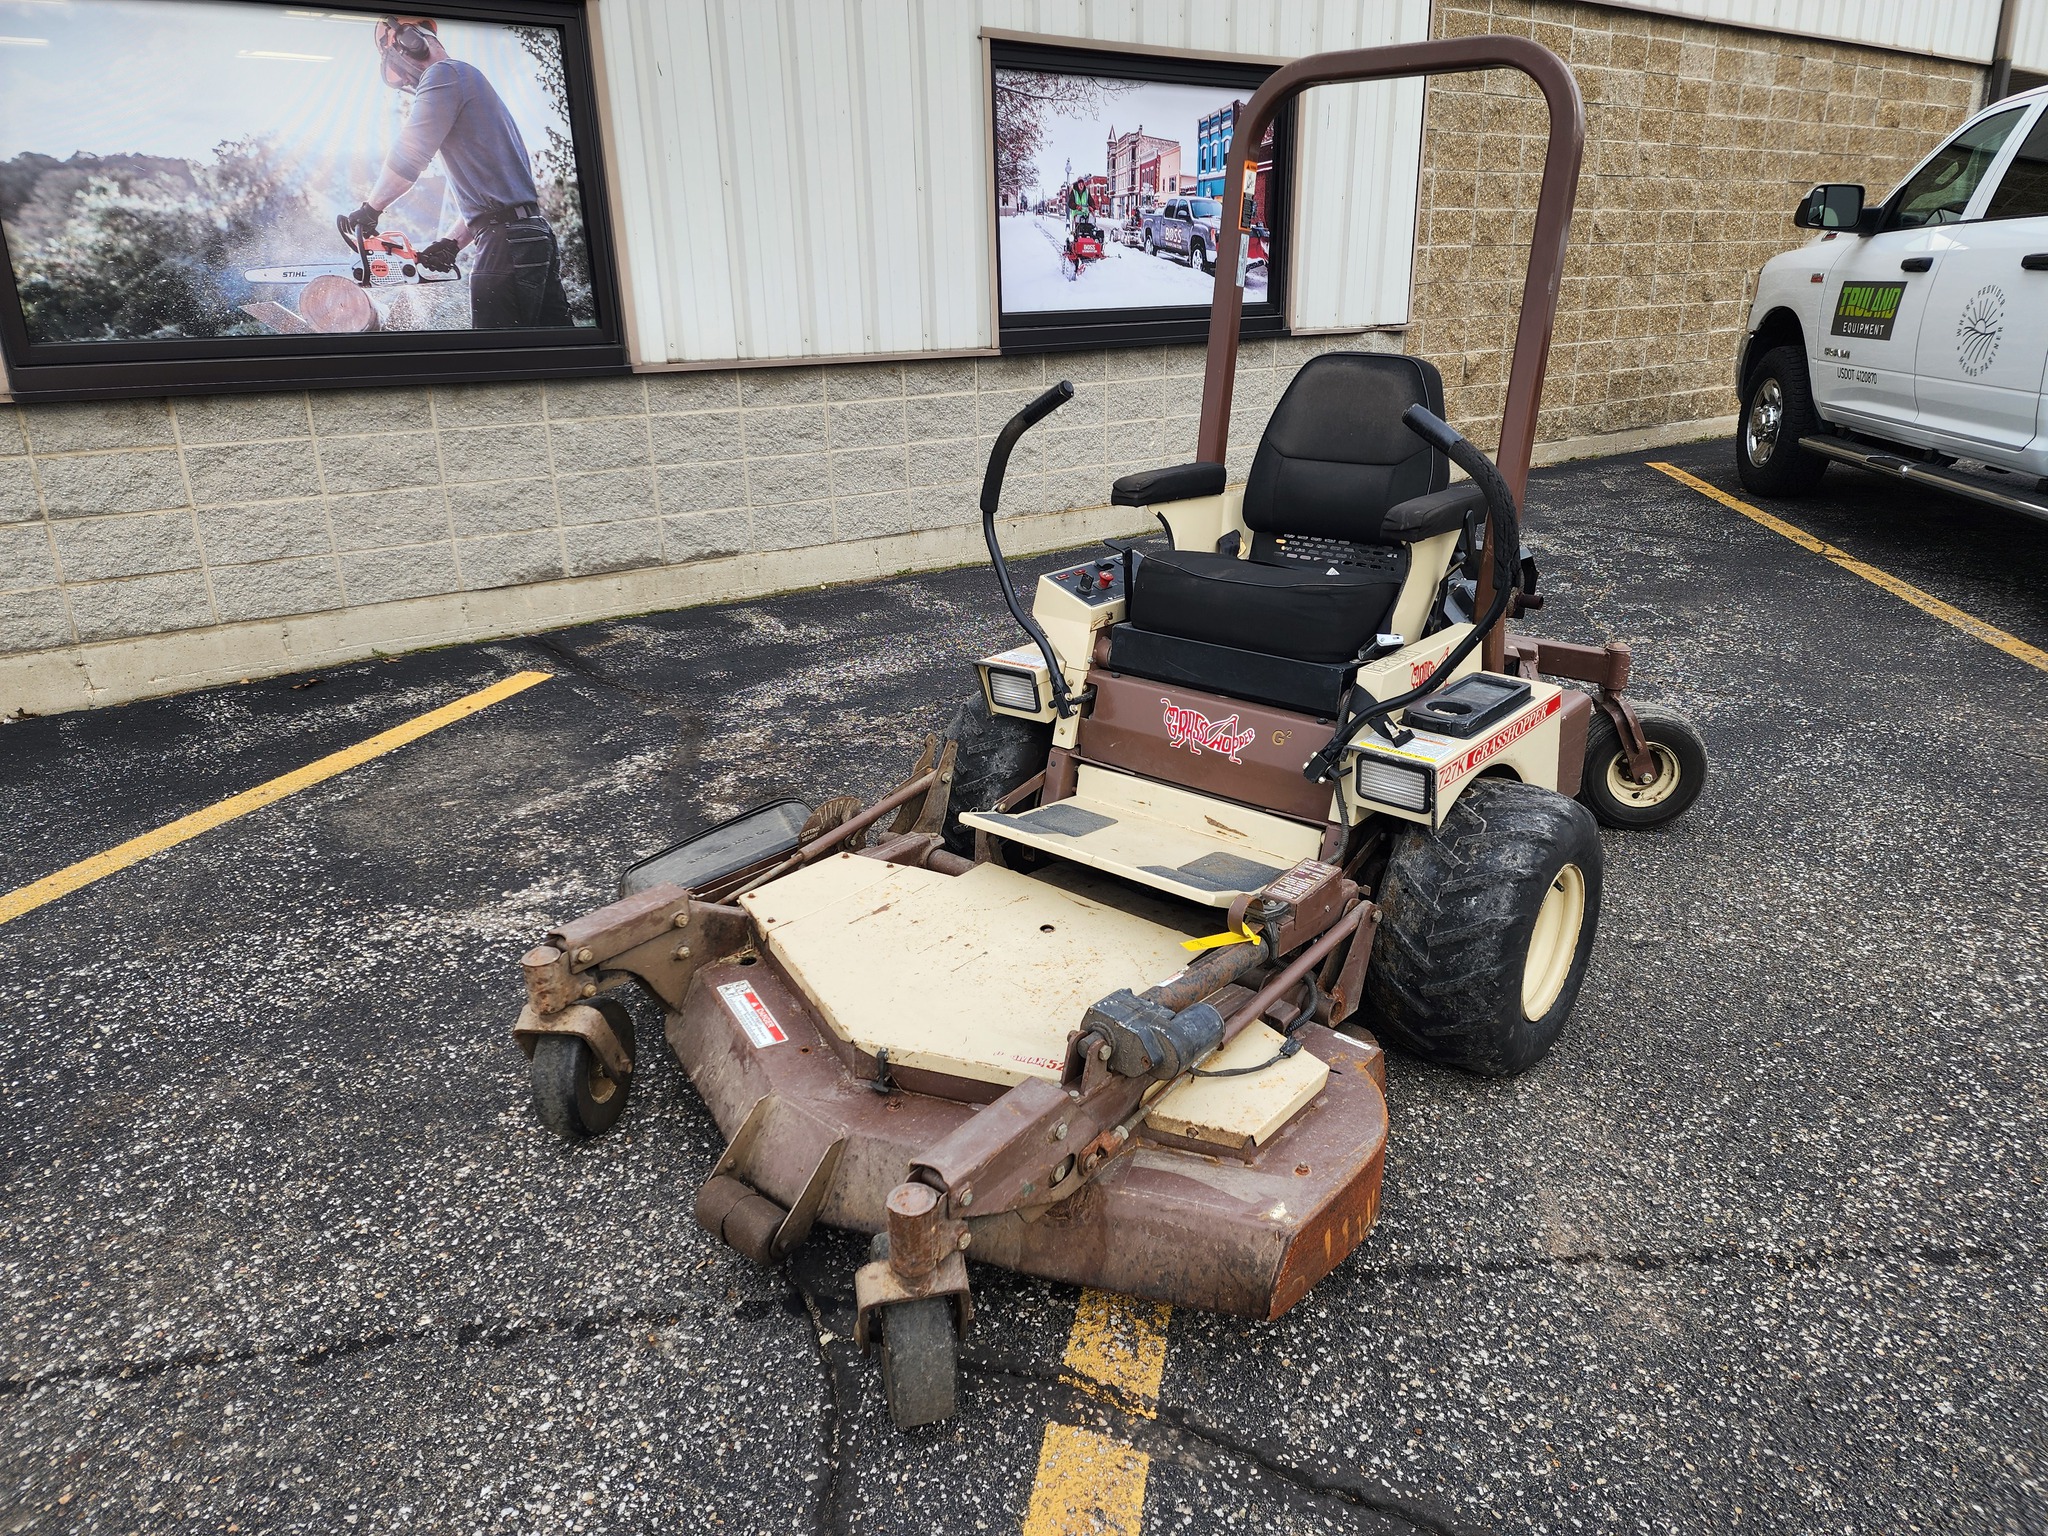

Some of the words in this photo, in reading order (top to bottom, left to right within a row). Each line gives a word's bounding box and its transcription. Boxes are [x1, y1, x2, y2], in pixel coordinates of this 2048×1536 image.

[1838, 286, 1902, 319] TRULAND
[1956, 297, 1974, 337] WHERE
[1842, 322, 1885, 336] EQUIPMENT
[1836, 366, 1855, 380] USDOT
[1162, 702, 1255, 760] GRASSHOPPER
[1438, 755, 1466, 789] 727K
[1472, 704, 1549, 765] GRASSHOPPER
[801, 825, 820, 838] CUTTING
[802, 832, 819, 842] HEIGHT
[755, 1008, 775, 1028] DANGER
